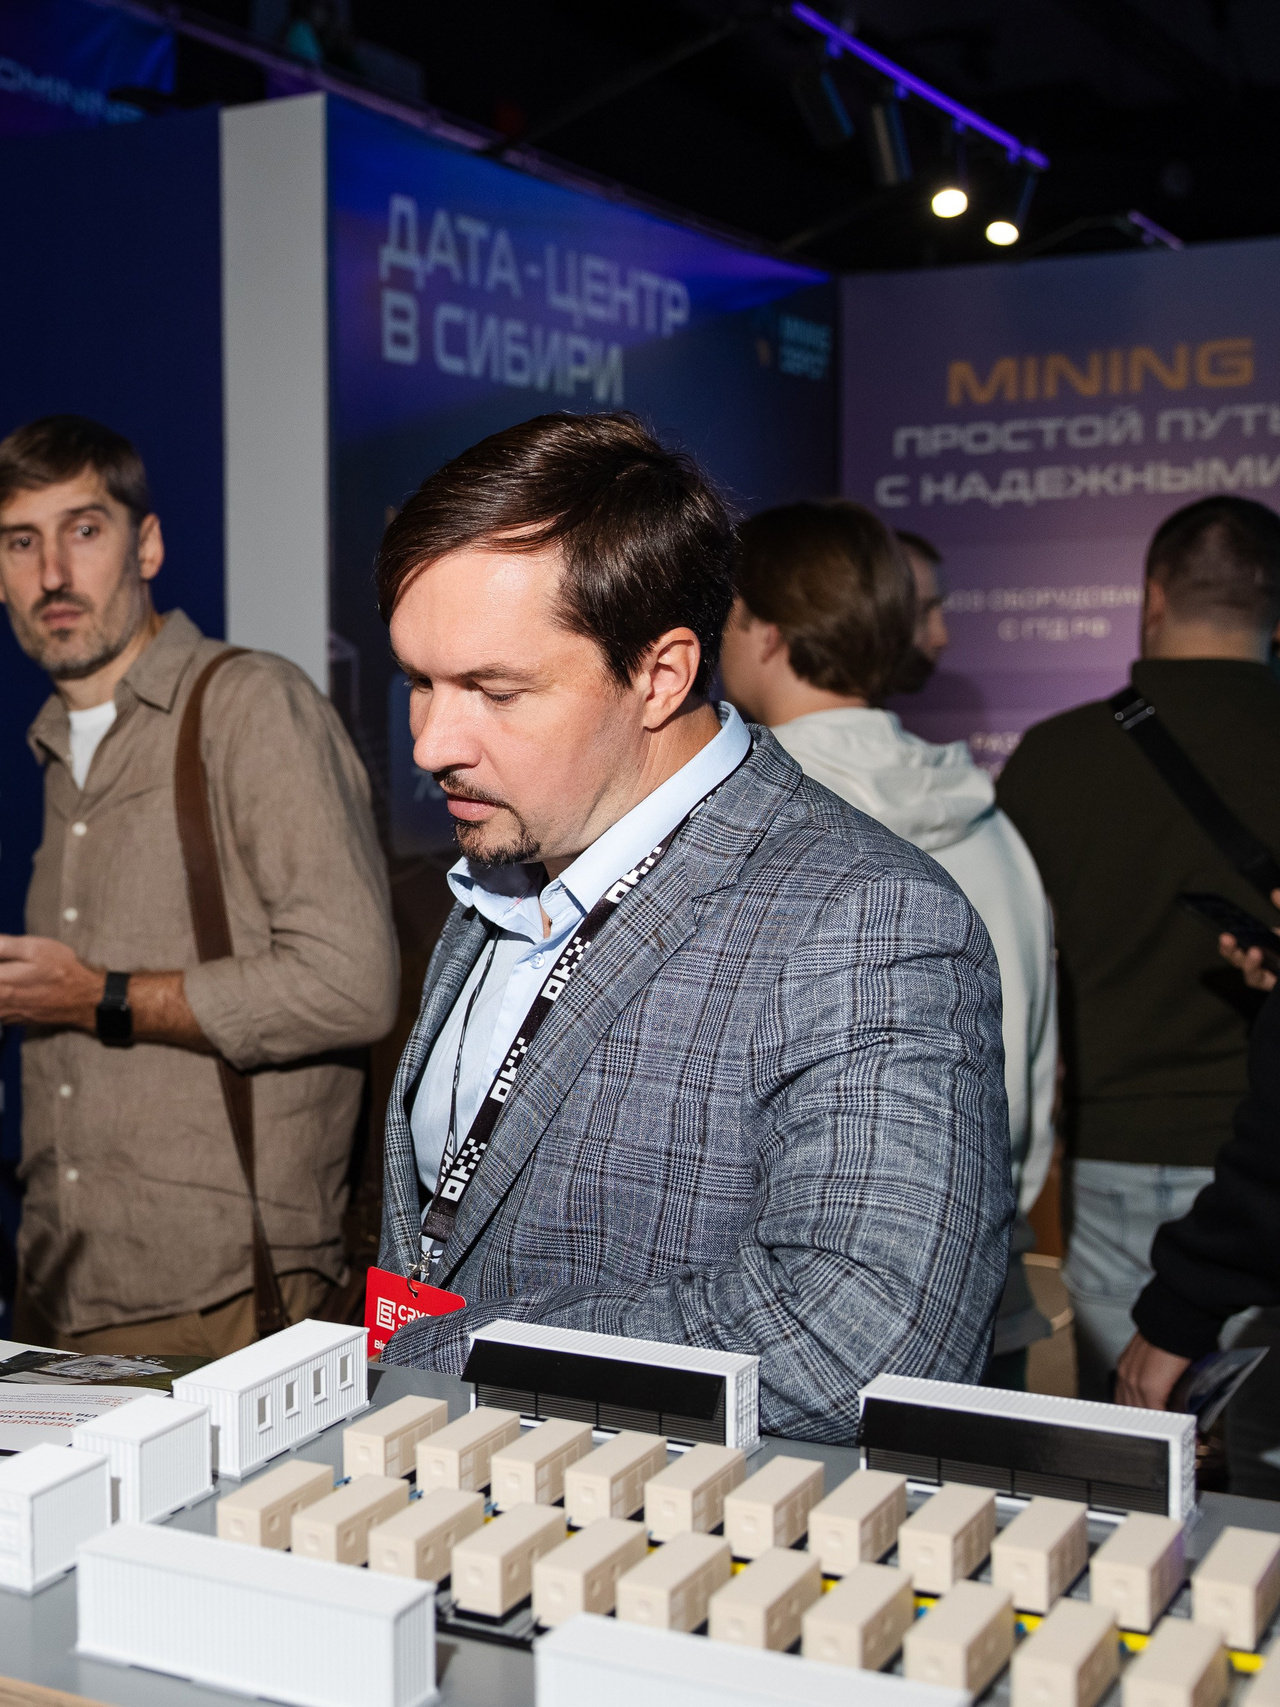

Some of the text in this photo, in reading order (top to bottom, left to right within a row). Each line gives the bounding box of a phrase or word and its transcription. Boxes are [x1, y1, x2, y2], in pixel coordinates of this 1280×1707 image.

[379, 193, 691, 337] ДАТА-ЦЕНТР
[381, 289, 623, 403] В СИБИРИ
[947, 338, 1255, 406] MINING
[892, 405, 1143, 458] ПРОСТОЙ
[875, 474, 912, 507] С
